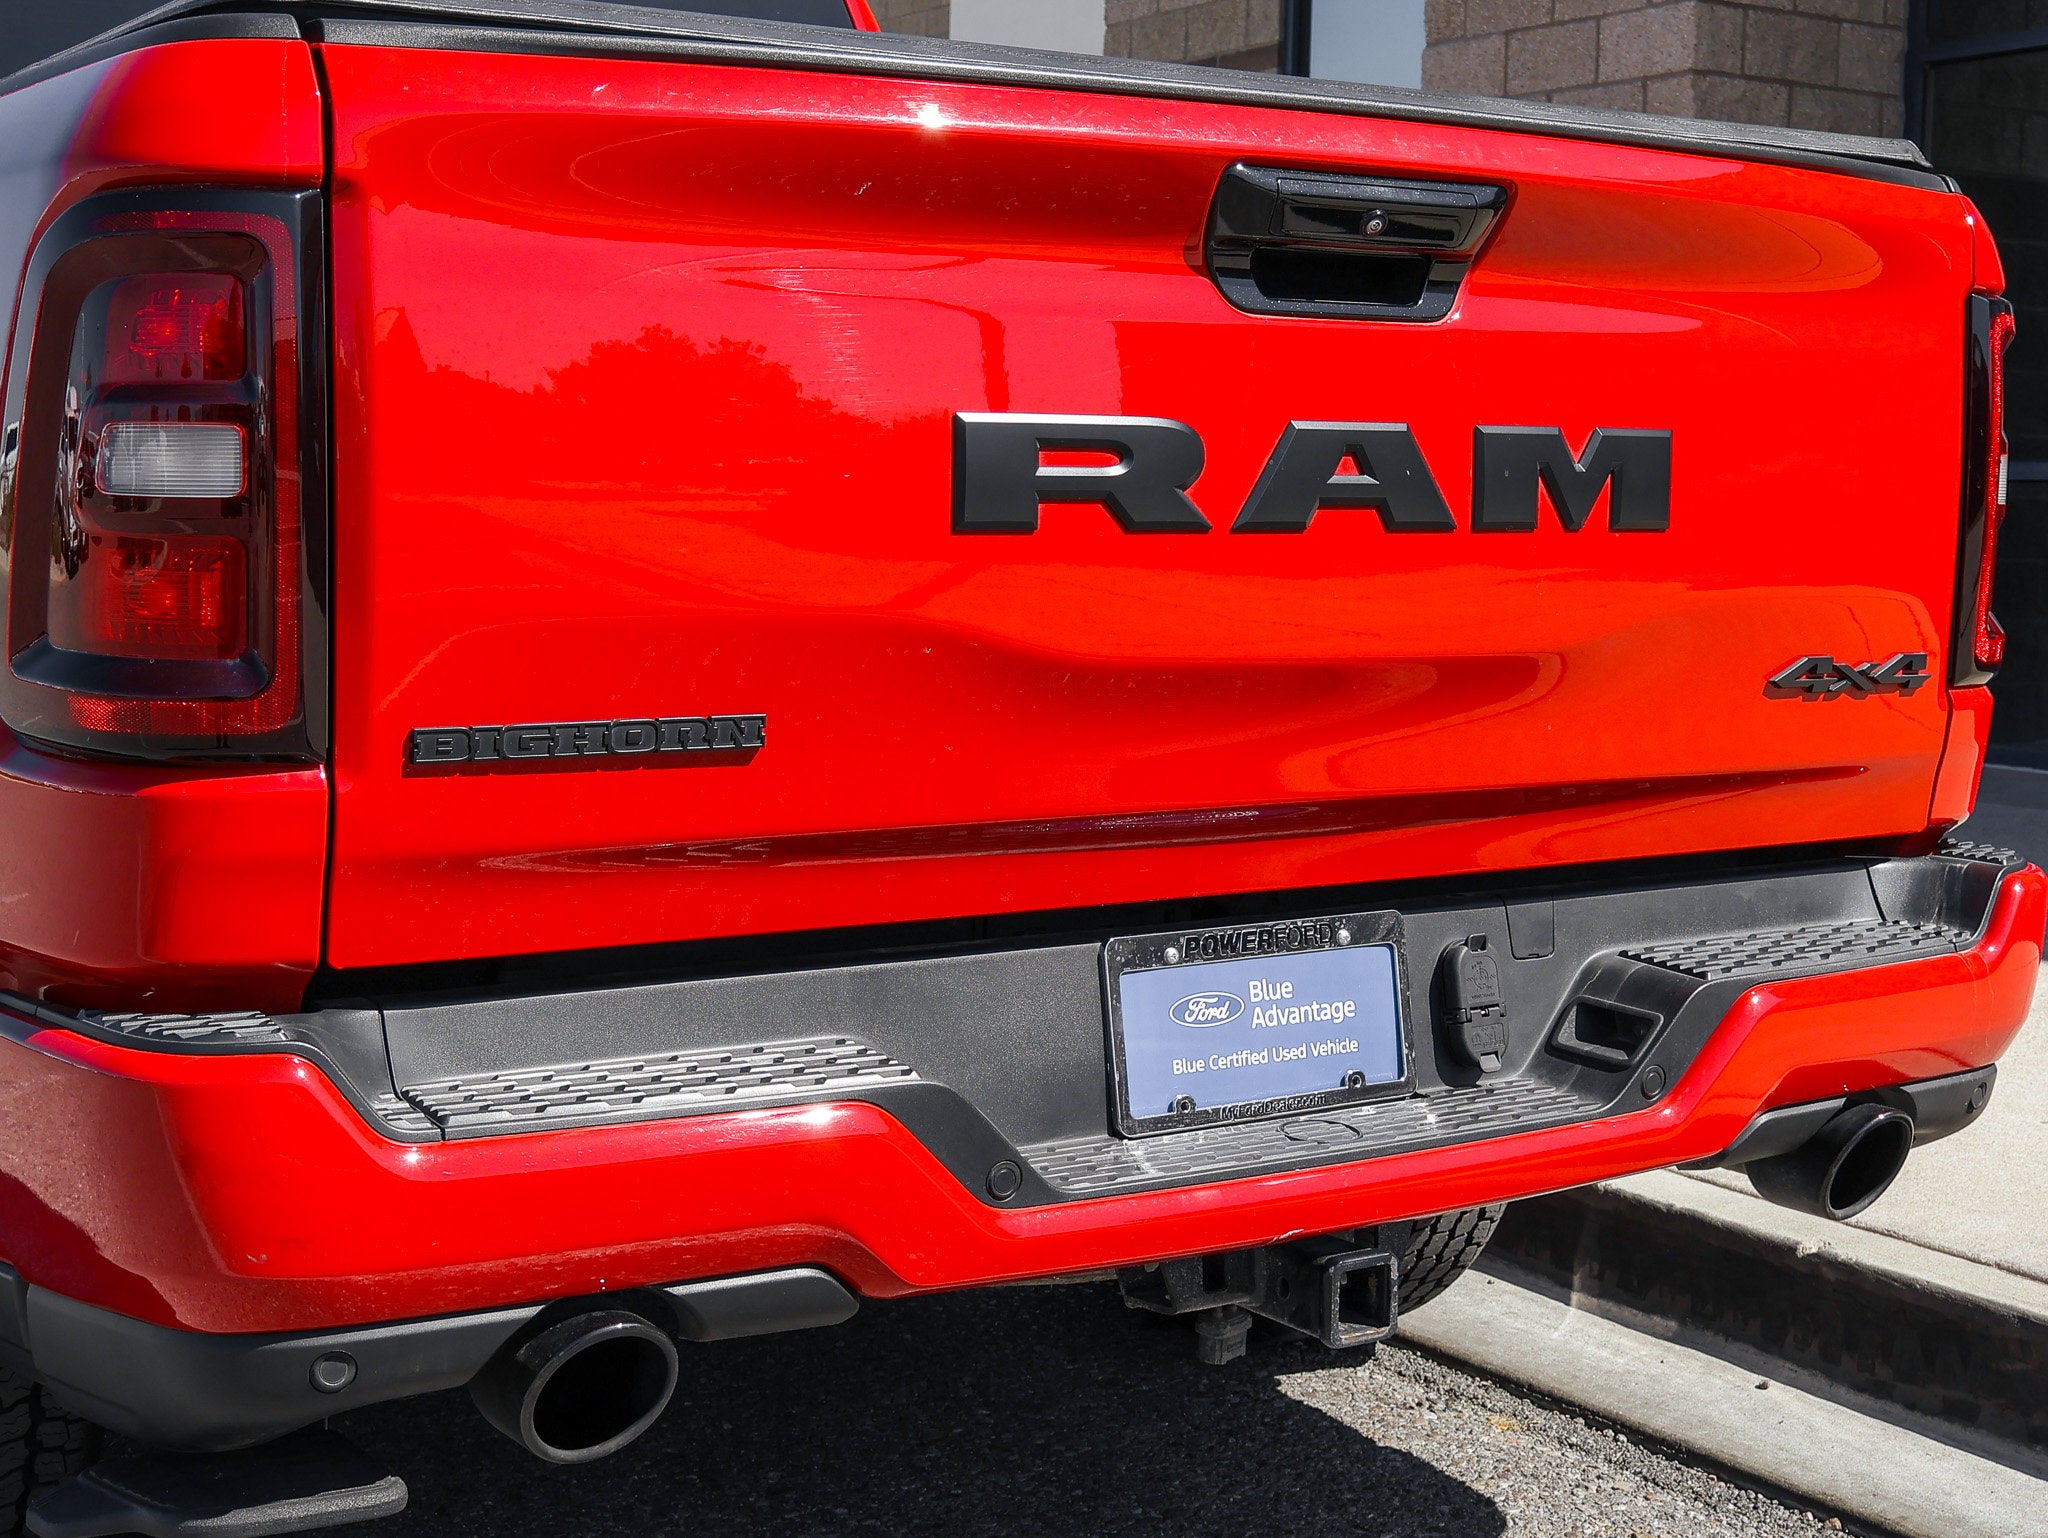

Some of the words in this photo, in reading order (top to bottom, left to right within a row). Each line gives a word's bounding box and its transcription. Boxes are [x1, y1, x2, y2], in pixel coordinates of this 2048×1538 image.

[951, 412, 1672, 534] RAM
[410, 713, 767, 765] BIGHORN
[1249, 978, 1294, 1002] Blue
[1184, 995, 1230, 1022] Ford
[1251, 999, 1356, 1029] Advantage
[1172, 1055, 1205, 1075] Blue
[1209, 1048, 1268, 1070] Certified
[1274, 1043, 1306, 1062] Used
[1310, 1037, 1359, 1057] Vehicle
[1220, 1094, 1327, 1121] MyFordDealer.com
